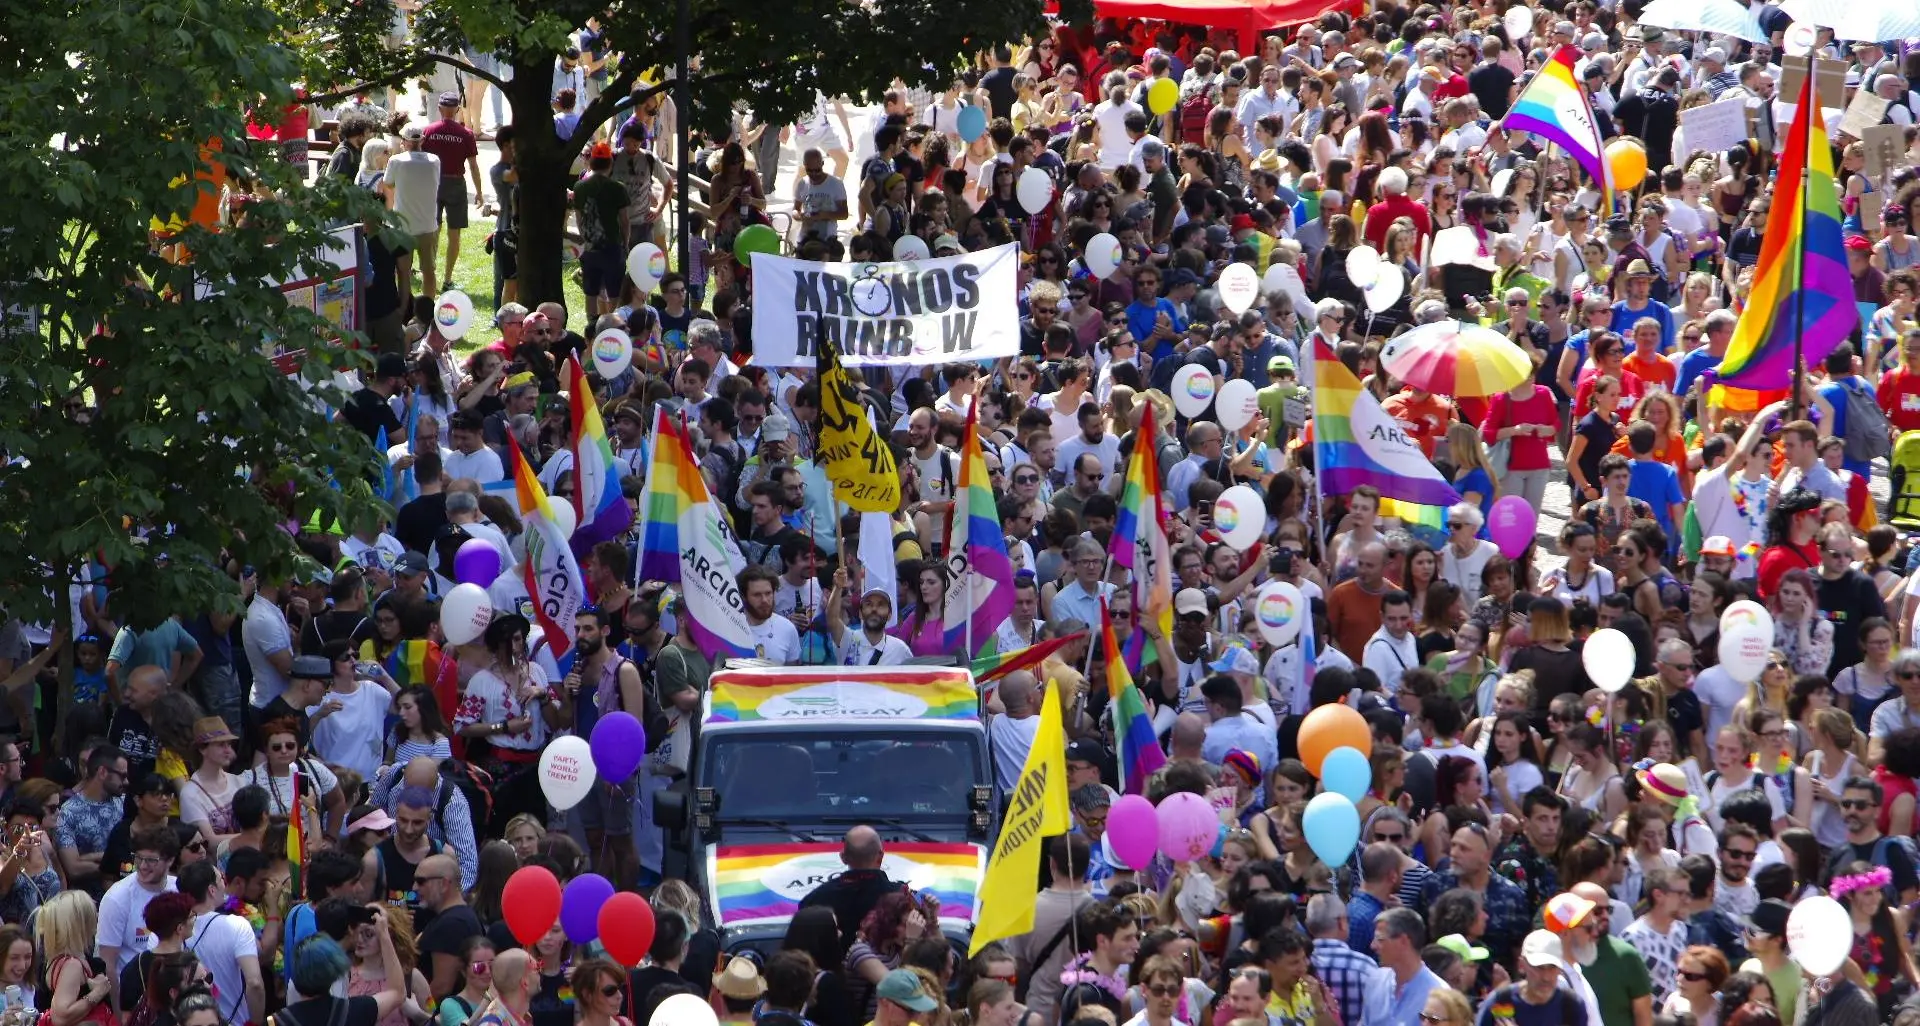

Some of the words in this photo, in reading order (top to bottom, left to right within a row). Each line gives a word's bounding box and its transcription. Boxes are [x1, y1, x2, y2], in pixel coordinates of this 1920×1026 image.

[777, 707, 906, 717] ARCIGAY
[553, 754, 578, 766] PARTY
[550, 763, 578, 774] WORLD
[547, 770, 578, 782] TRENTO
